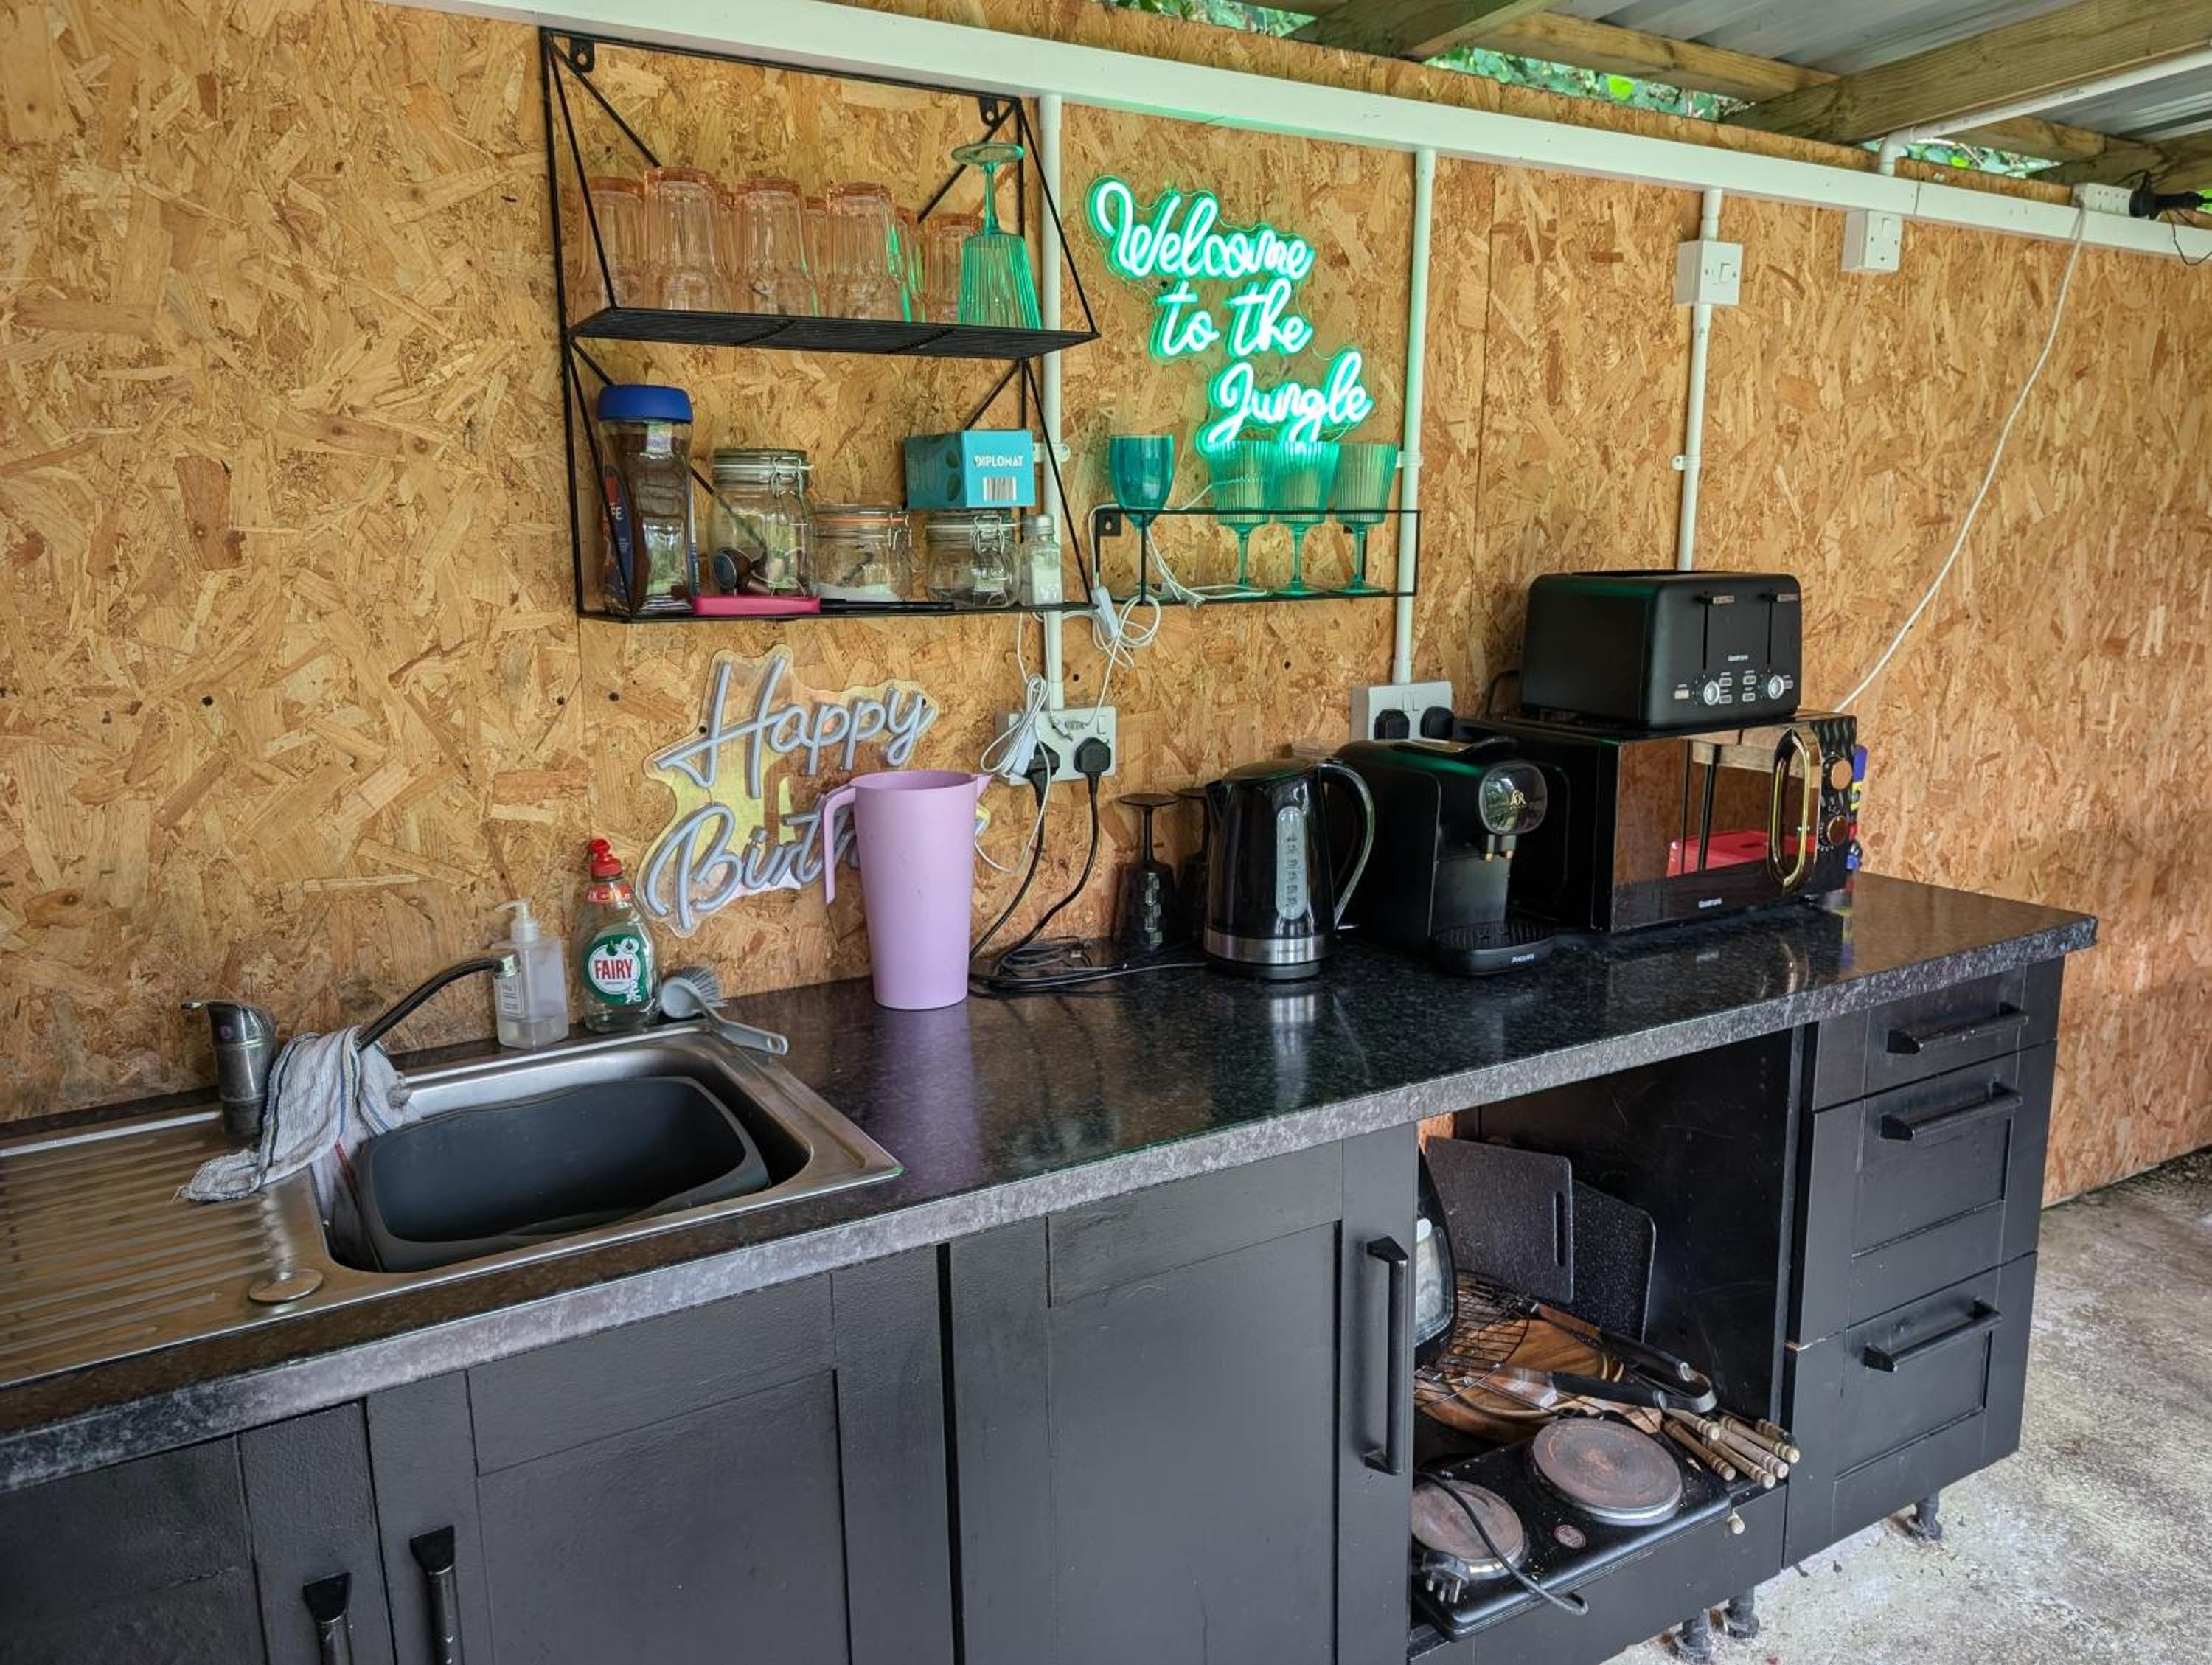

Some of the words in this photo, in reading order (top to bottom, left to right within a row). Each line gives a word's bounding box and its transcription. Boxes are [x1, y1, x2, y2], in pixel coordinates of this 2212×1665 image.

[1091, 179, 1314, 282] Welcome
[1159, 280, 1220, 357] to
[1225, 276, 1312, 357] the
[1205, 350, 1373, 449] Jungle
[973, 454, 1023, 467] DIPLOMAT
[653, 653, 936, 800] Happy
[645, 793, 991, 931] Birth
[594, 959, 633, 980] FAIRY
